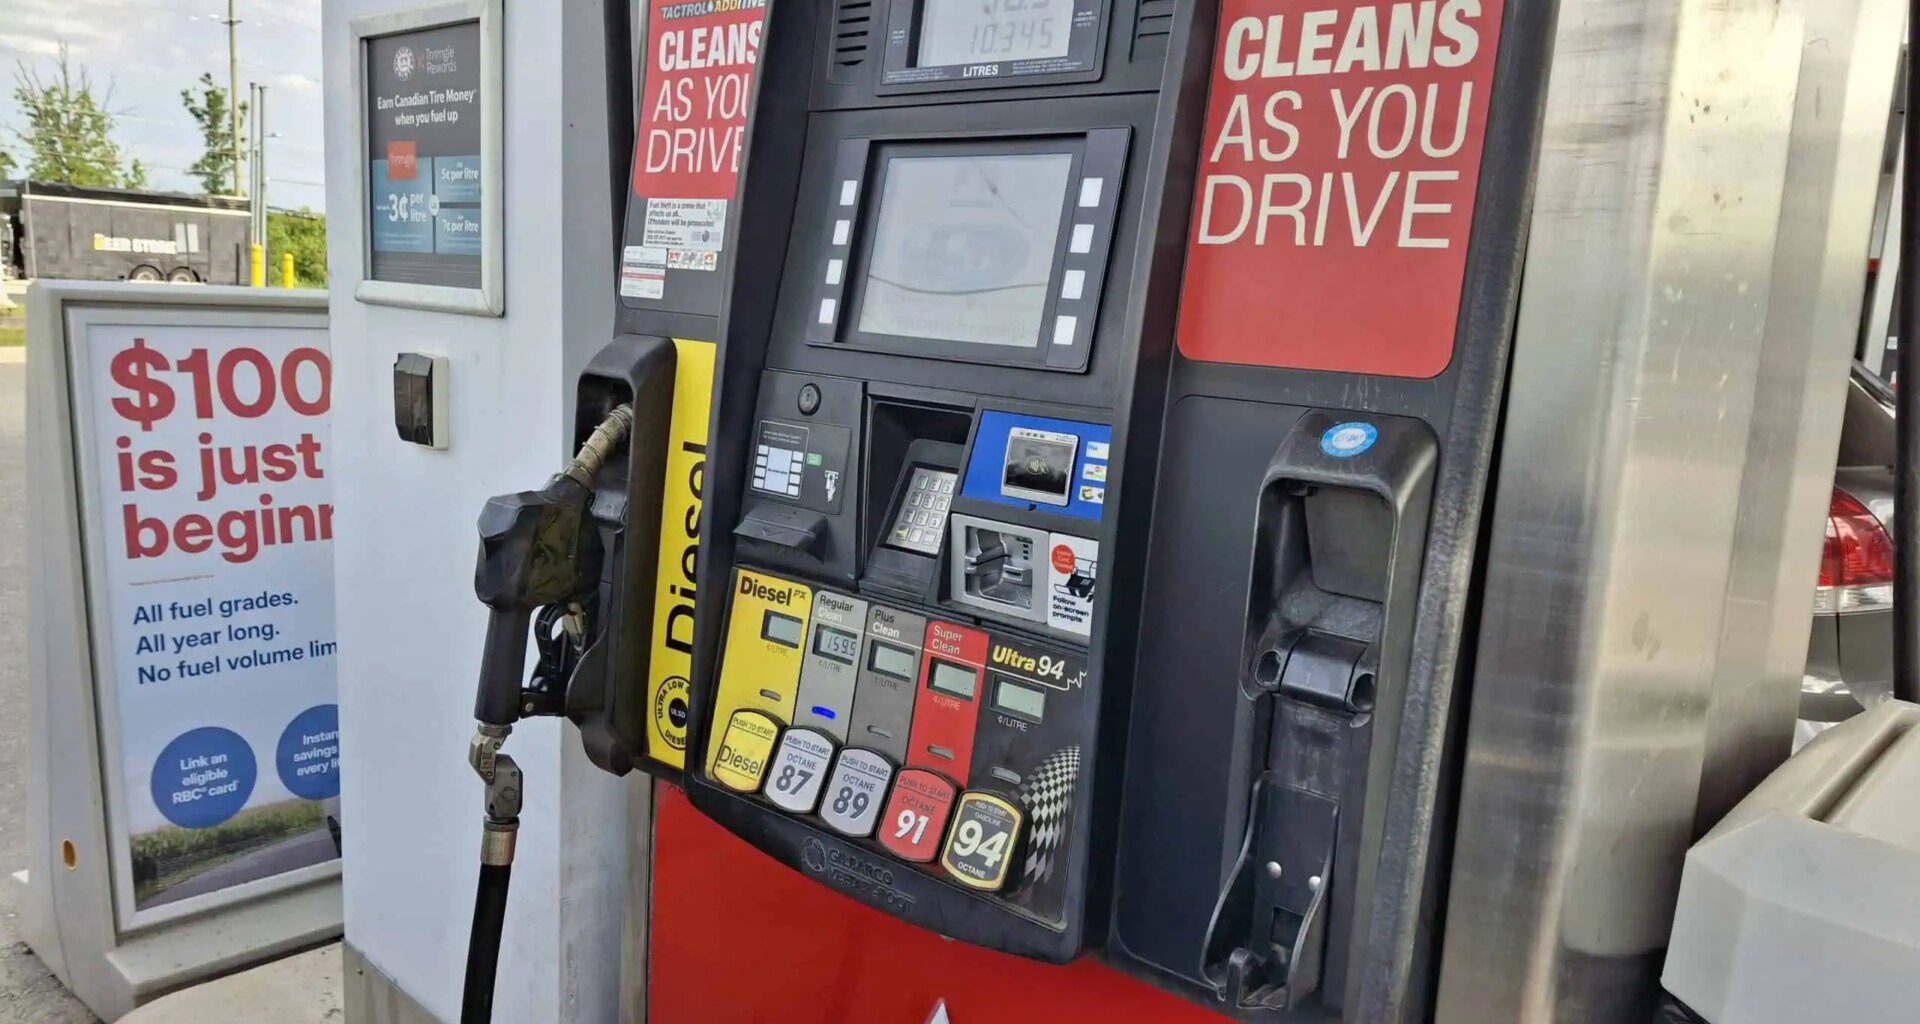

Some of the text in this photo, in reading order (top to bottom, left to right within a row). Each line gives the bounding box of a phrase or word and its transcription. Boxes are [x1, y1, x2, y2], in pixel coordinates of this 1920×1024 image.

[661, 1, 708, 20] TACTROL
[658, 20, 764, 72] CLEANS
[1223, 0, 1482, 81] CLEANS
[962, 64, 999, 77] LITRES
[377, 96, 394, 110] Earn
[394, 92, 429, 108] Canadian
[429, 90, 445, 105] Tire
[652, 76, 694, 122] AS
[395, 109, 459, 127] when you fuel up
[1209, 81, 1474, 162] AS YOU
[409, 193, 425, 207] per
[1198, 170, 1460, 249] DRIVE
[410, 209, 428, 223] litre
[116, 432, 324, 502] is just
[740, 576, 792, 606] Diesel
[1052, 595, 1076, 607] Follow
[133, 591, 298, 625] All fuel grades.
[819, 594, 854, 612] Regular
[1052, 604, 1089, 617] on-screen
[818, 607, 843, 622] Clean
[874, 609, 895, 624] Plus
[1052, 611, 1083, 624] prompts
[135, 624, 280, 655] All year long.
[872, 622, 900, 639] Clean
[933, 626, 963, 642] Super
[931, 639, 960, 655] Clean
[137, 664, 171, 684] No
[177, 656, 220, 679] fuel
[226, 646, 304, 671] volume
[992, 644, 1066, 681] Ultra 94
[656, 680, 685, 719] ULTRA LOW
[733, 716, 775, 739] PUSH TO START
[293, 746, 337, 763] savings
[786, 735, 831, 757] PUSH TO START
[180, 753, 228, 771] Link an
[297, 761, 329, 777] every
[719, 745, 765, 777] Diesel
[786, 753, 818, 771] OCTANE
[841, 754, 889, 778] PUSH TO START
[182, 768, 228, 787] eligible
[776, 764, 814, 796] 87
[843, 773, 876, 793] OCTANE
[832, 786, 870, 820] 89
[901, 795, 937, 816] OCTANE
[894, 809, 929, 845] 91
[953, 819, 1009, 868] 94
[957, 861, 987, 879] OCTANE
